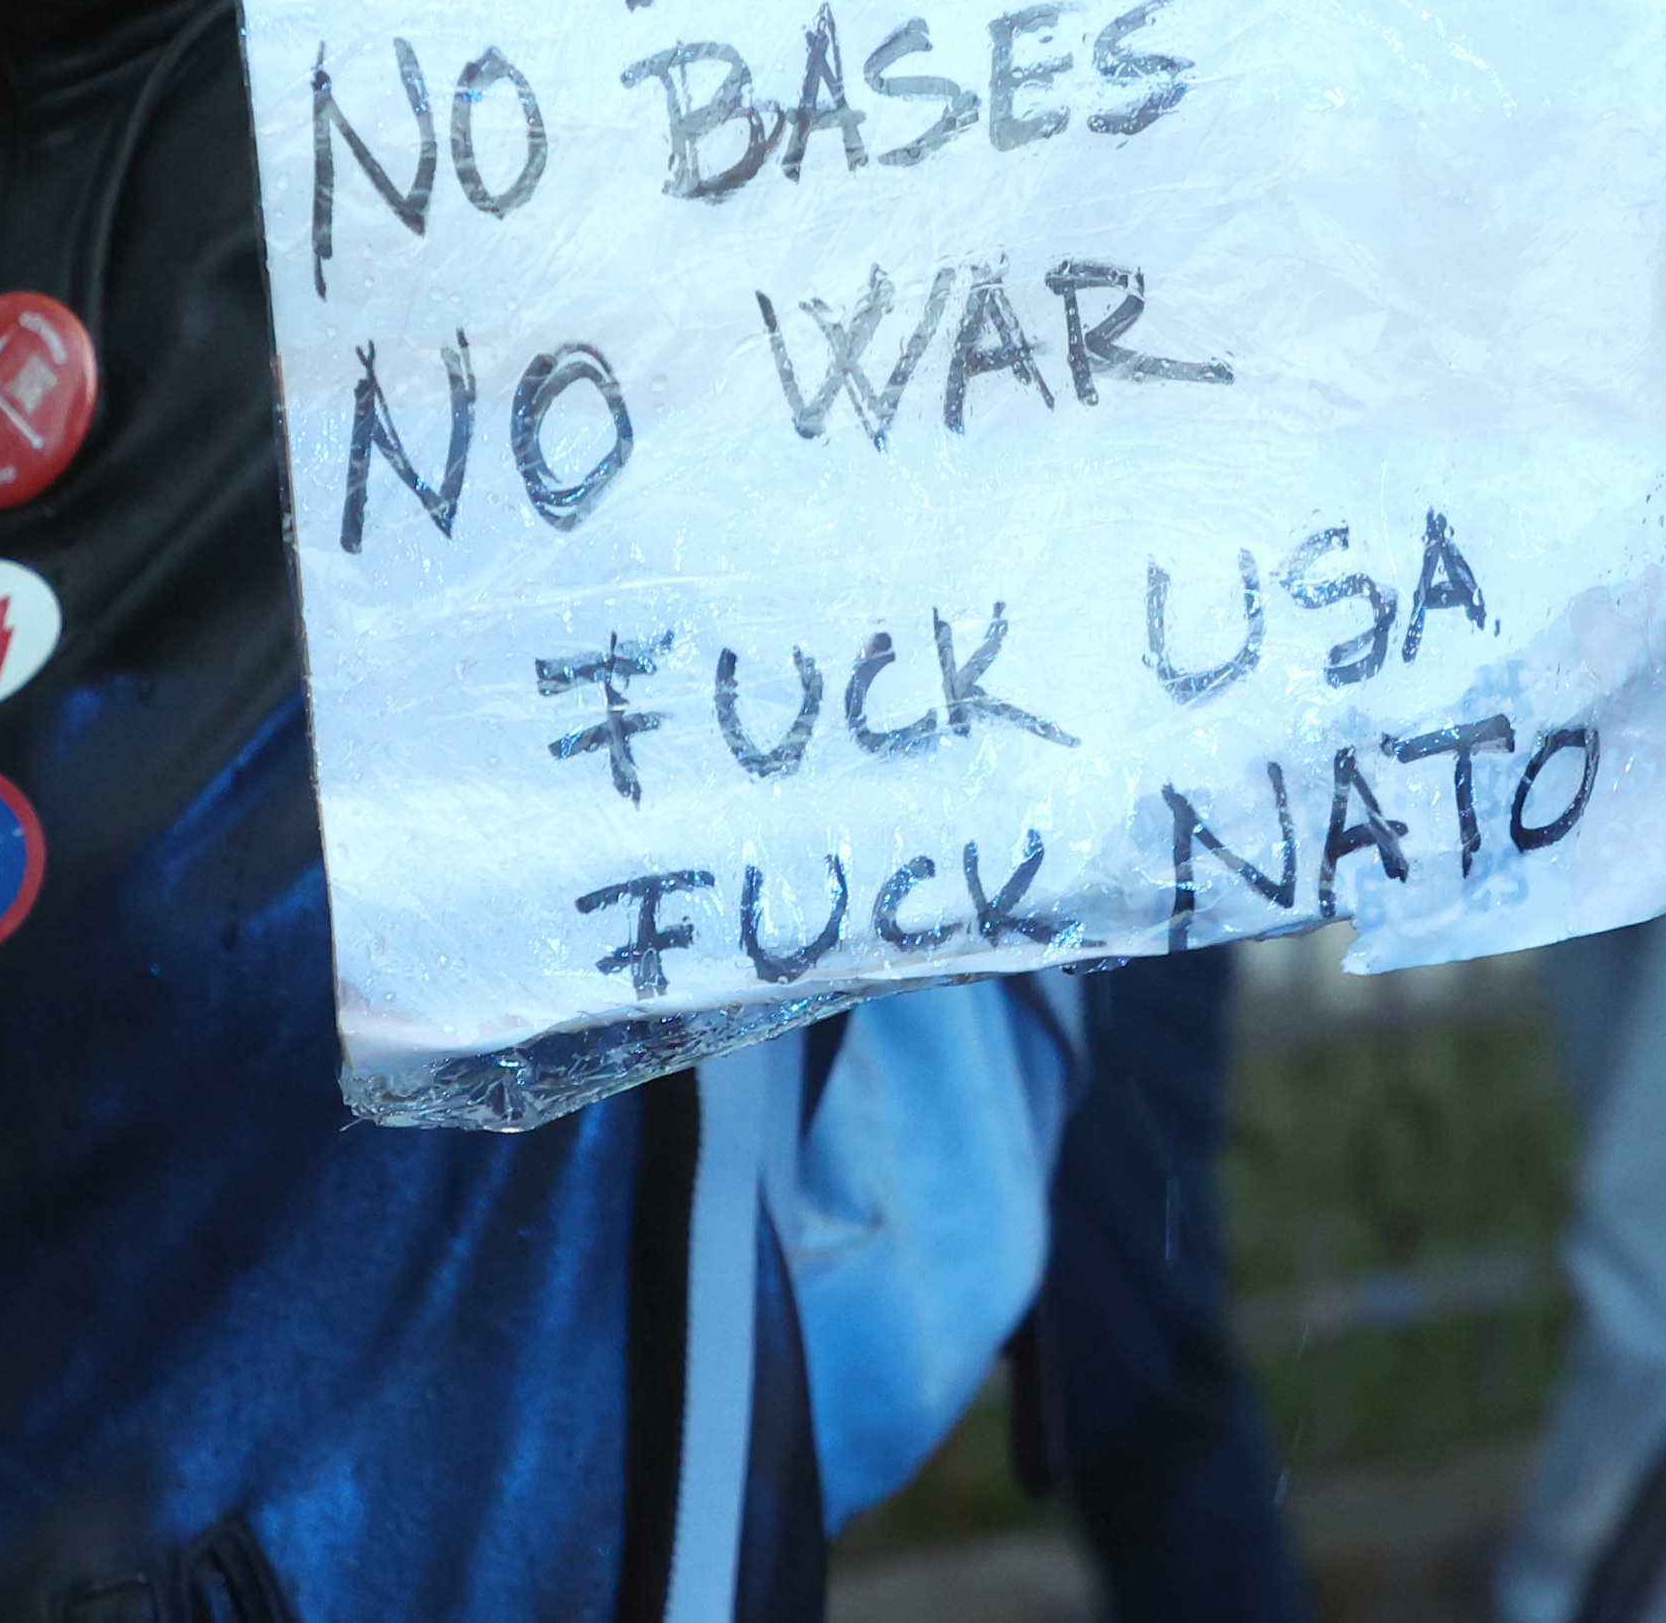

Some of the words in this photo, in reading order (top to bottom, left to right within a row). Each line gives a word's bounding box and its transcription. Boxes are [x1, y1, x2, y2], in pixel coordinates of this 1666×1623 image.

[311, 36, 547, 300] NO
[338, 328, 635, 554] NO
[753, 256, 1236, 452] WAR
[534, 599, 1081, 806] FUCK
[1143, 505, 1489, 700] USA
[574, 828, 1101, 996] FUCK
[1161, 713, 1601, 952] NATO
